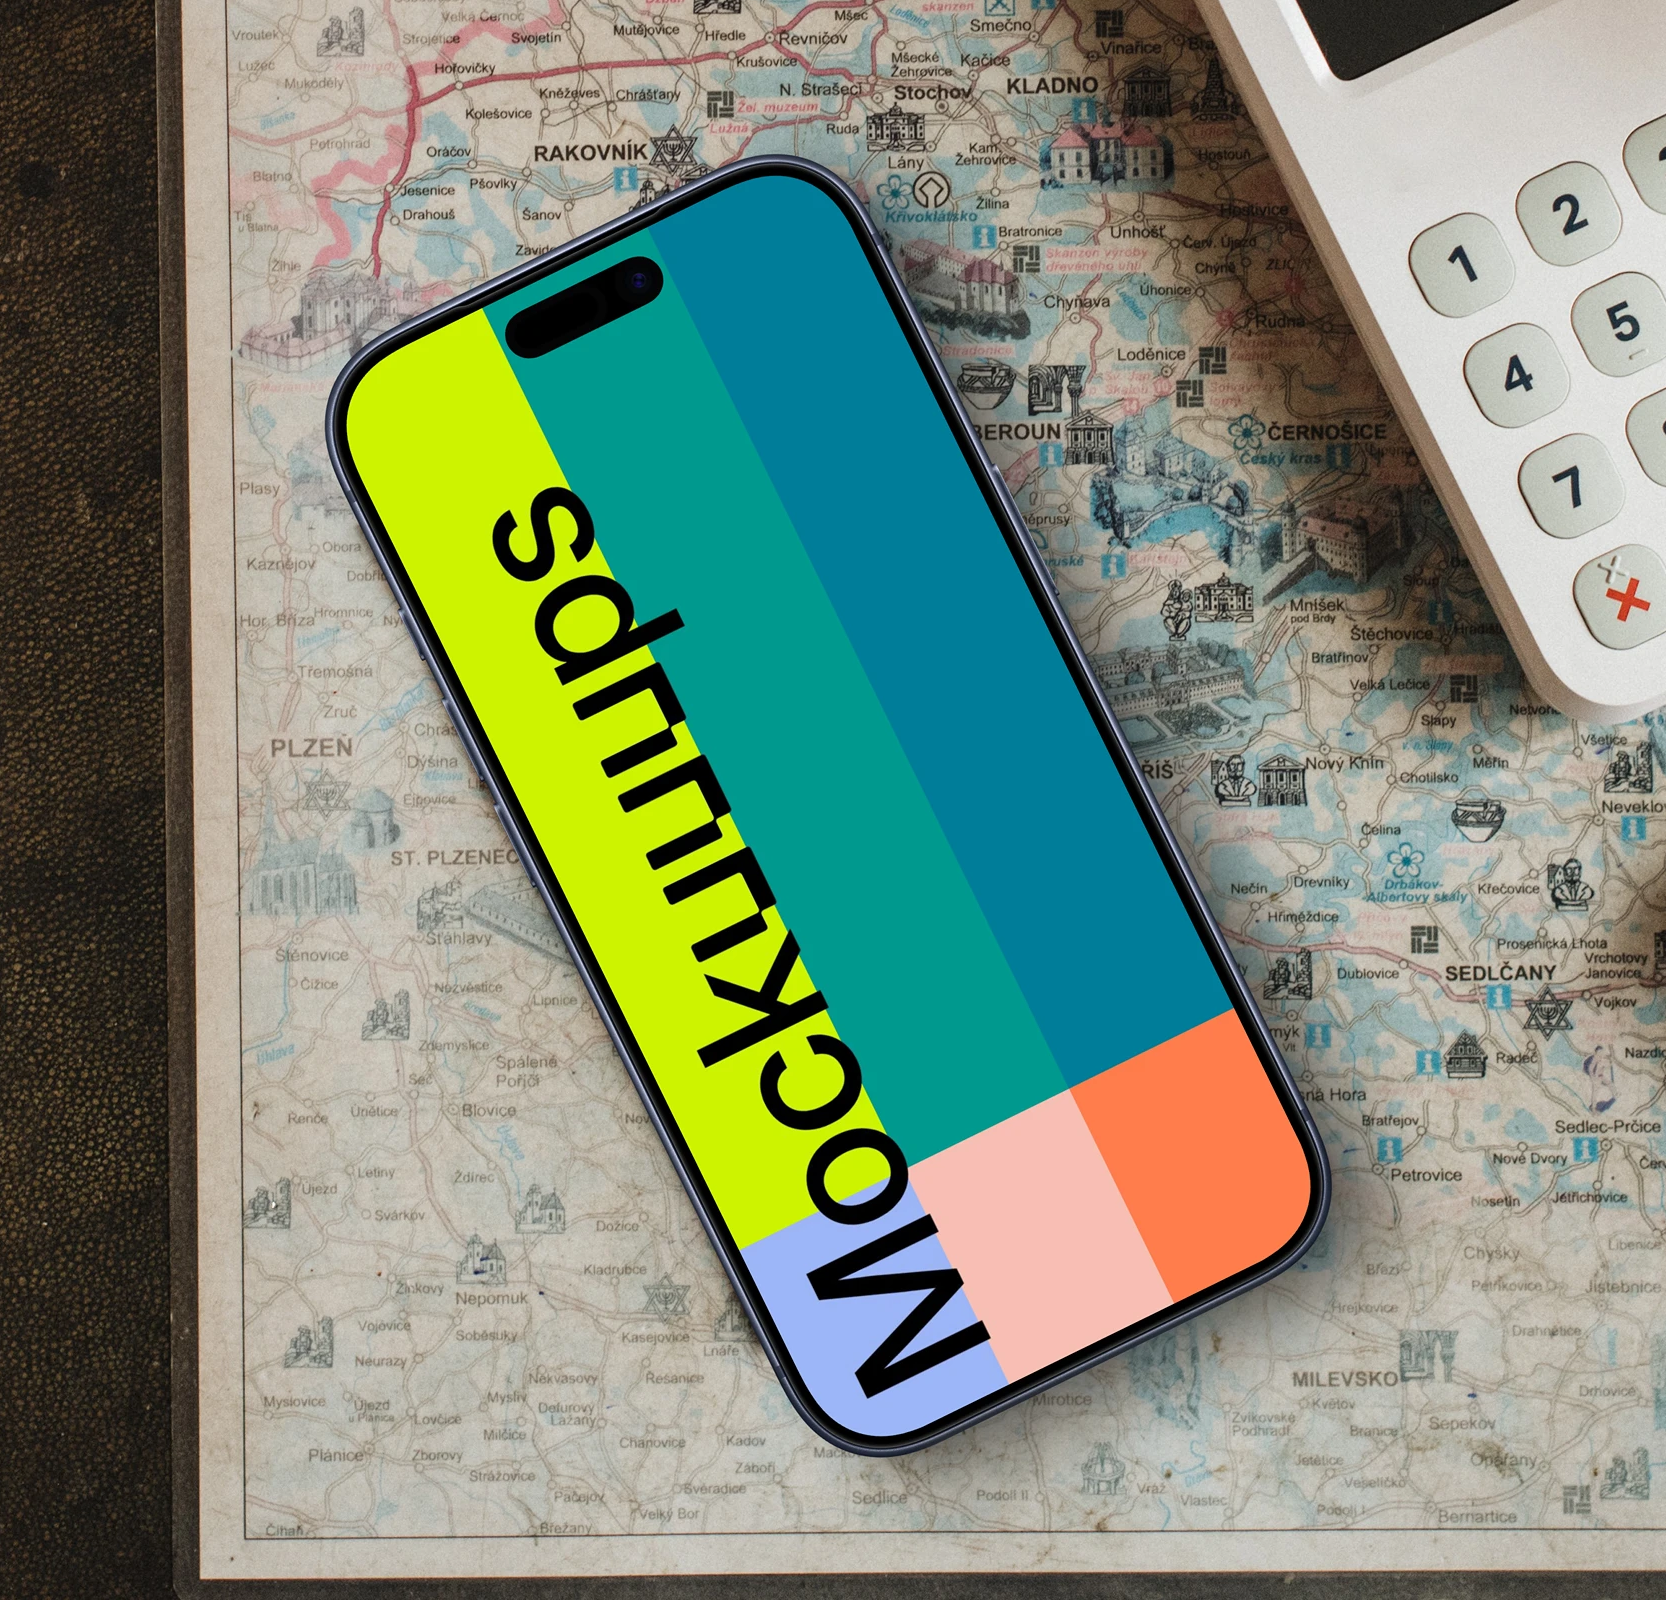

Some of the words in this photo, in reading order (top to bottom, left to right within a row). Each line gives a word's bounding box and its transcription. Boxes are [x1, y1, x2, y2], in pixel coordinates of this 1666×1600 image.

[971, 19, 1031, 33] Smečno
[512, 31, 562, 47] Svojetín
[780, 29, 848, 46] Řevničov
[1101, 39, 1161, 55] Vinařice
[434, 61, 495, 77] Hořovičky
[736, 54, 797, 68] Krušovice
[895, 84, 971, 101] Stochov
[1007, 76, 1098, 95] KLADNO
[465, 106, 532, 120] Kolešovice
[535, 142, 648, 162] RAKOVNÍK
[400, 184, 455, 198] Jesenice
[404, 206, 455, 222] Drahouš
[1552, 193, 1589, 236] 2
[1447, 244, 1478, 283] 1
[1606, 300, 1641, 342] 5
[1117, 345, 1185, 363] Loděnice
[1504, 354, 1533, 392] 4
[1267, 419, 1387, 441] ČERNOŠICE
[1551, 465, 1582, 509] 7
[1350, 623, 1434, 643] Štěchovice
[297, 664, 372, 680] Třemošná
[271, 737, 353, 758] PLZEŇ
[492, 486, 991, 1399] Mockuuups
[1446, 963, 1556, 982] SEDLČANY
[462, 1102, 517, 1119] Blovice
[1555, 1118, 1661, 1136] Sedlec-Prčice
[456, 1290, 528, 1307] Nepomuk
[621, 1331, 690, 1346] Kasejovice
[1293, 1370, 1399, 1388] MILEVSKO
[308, 1447, 364, 1463] Plánice
[1438, 1509, 1517, 1524] Bernartice
